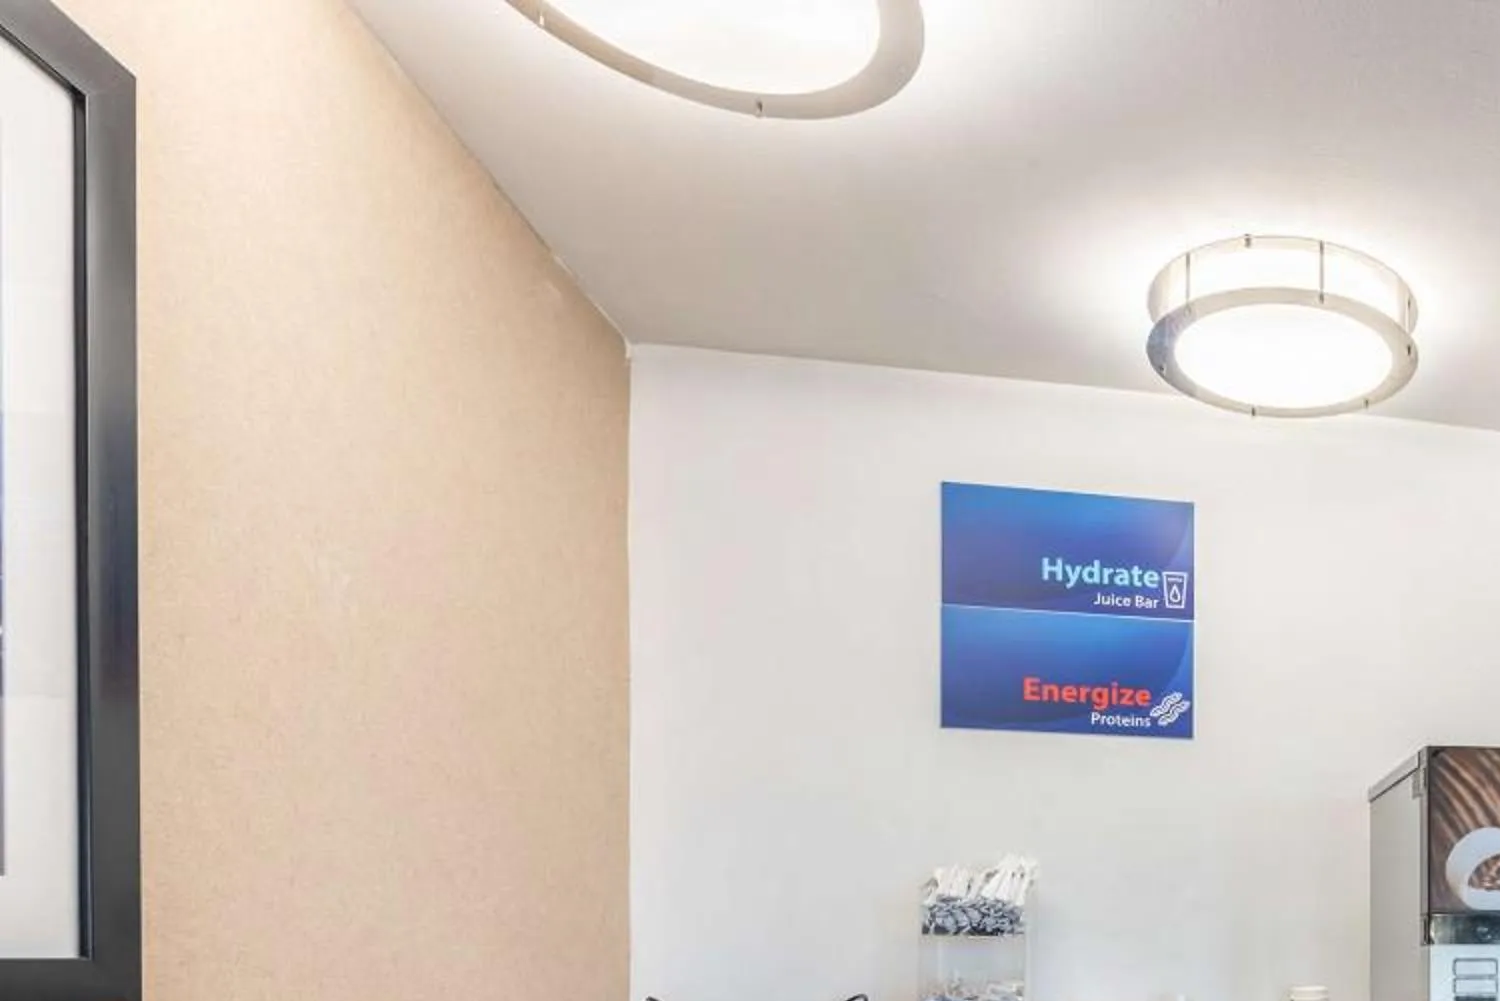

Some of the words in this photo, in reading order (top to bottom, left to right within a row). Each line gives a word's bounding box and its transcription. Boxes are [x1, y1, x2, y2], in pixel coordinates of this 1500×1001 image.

[1041, 556, 1161, 590] Hydrate
[1092, 592, 1131, 608] Juice
[1135, 594, 1159, 609] Bar
[1022, 675, 1152, 712] Energize
[1090, 711, 1152, 727] Proteins
